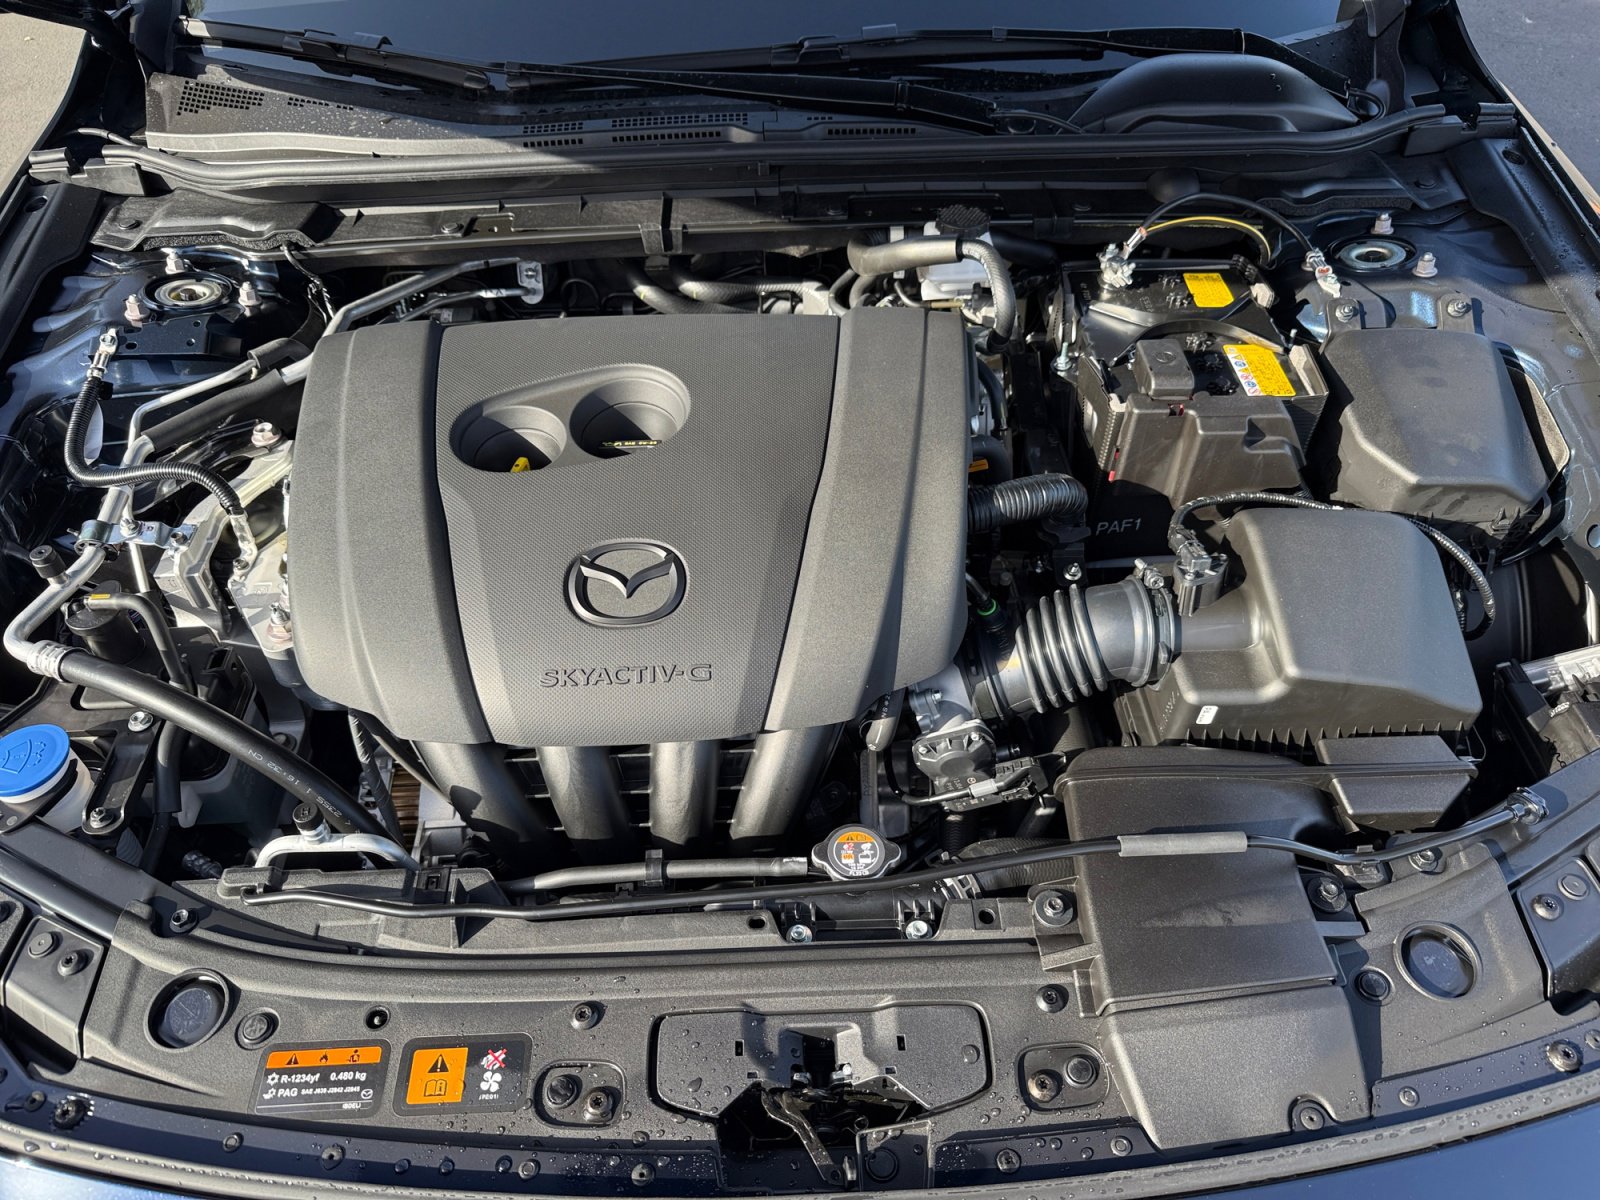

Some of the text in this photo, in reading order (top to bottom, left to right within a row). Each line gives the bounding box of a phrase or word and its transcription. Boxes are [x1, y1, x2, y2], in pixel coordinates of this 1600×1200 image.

[1095, 518, 1142, 536] PAF1
[540, 663, 713, 688] SKYACTIV-G
[280, 1071, 367, 1085] R-1234yf 0.480 kg
[277, 1088, 298, 1098] PAG
